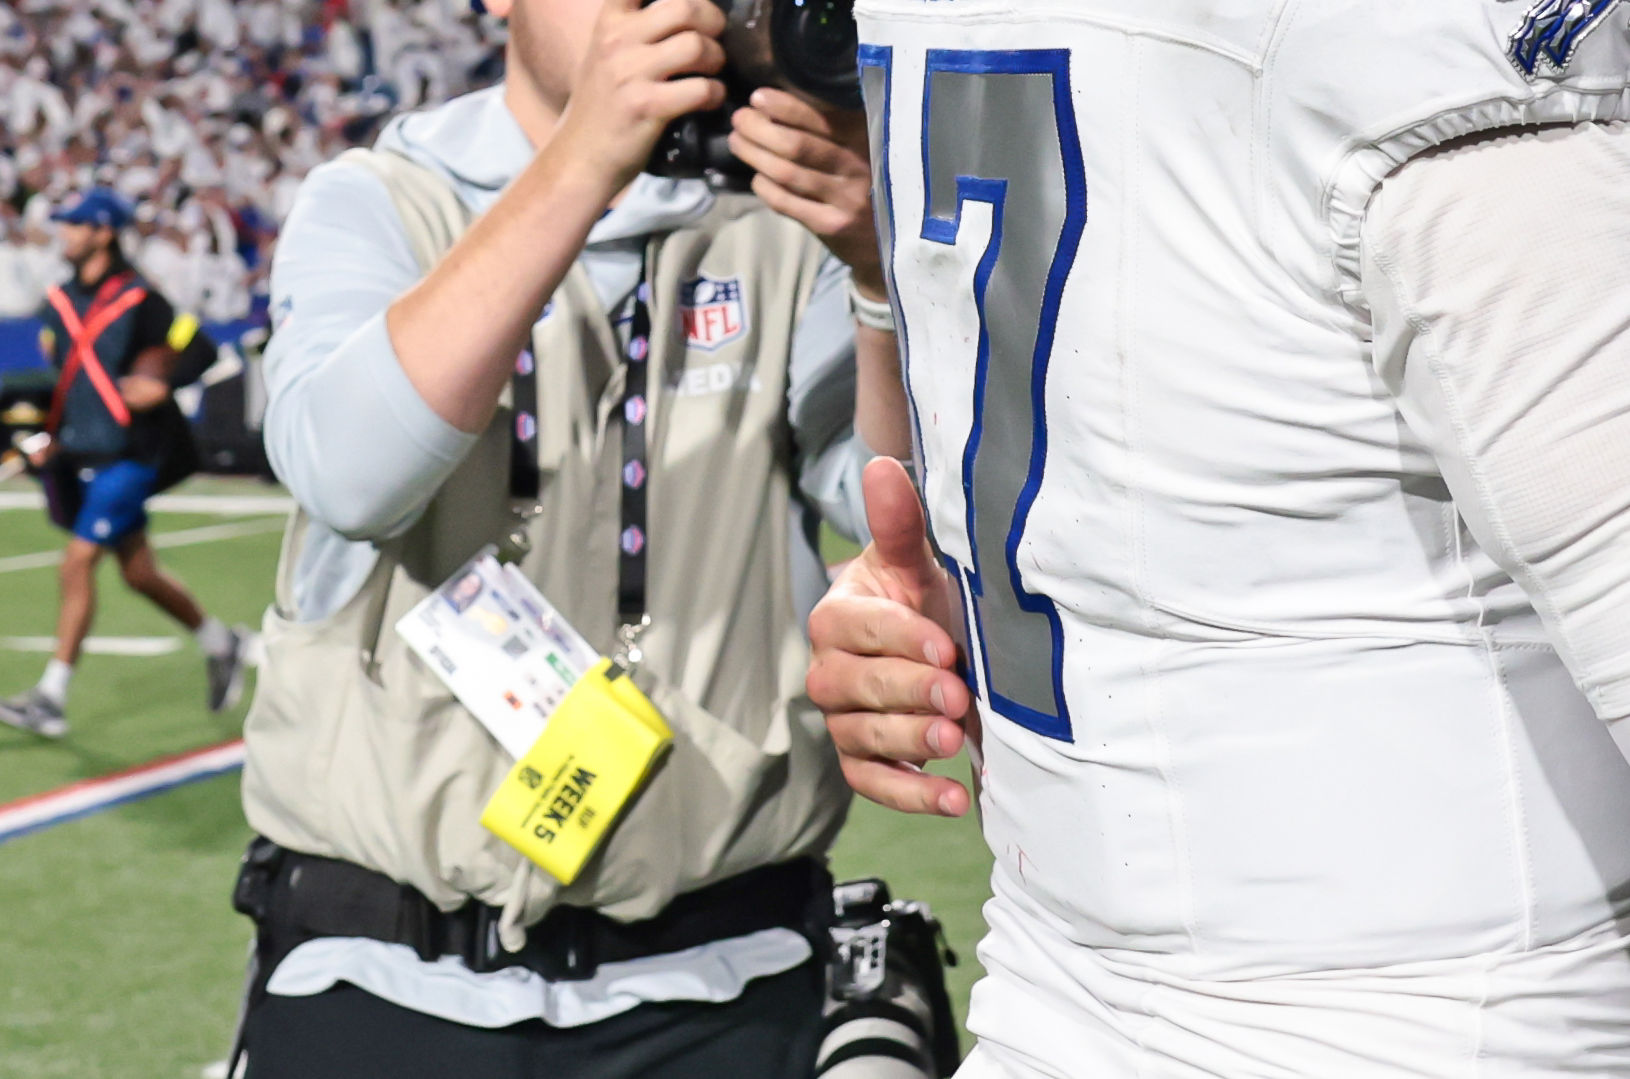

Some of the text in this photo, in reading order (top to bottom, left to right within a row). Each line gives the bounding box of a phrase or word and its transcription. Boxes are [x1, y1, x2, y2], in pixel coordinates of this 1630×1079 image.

[681, 305, 741, 342] NFL
[541, 766, 598, 829] WEEK
[533, 823, 557, 845] 5
